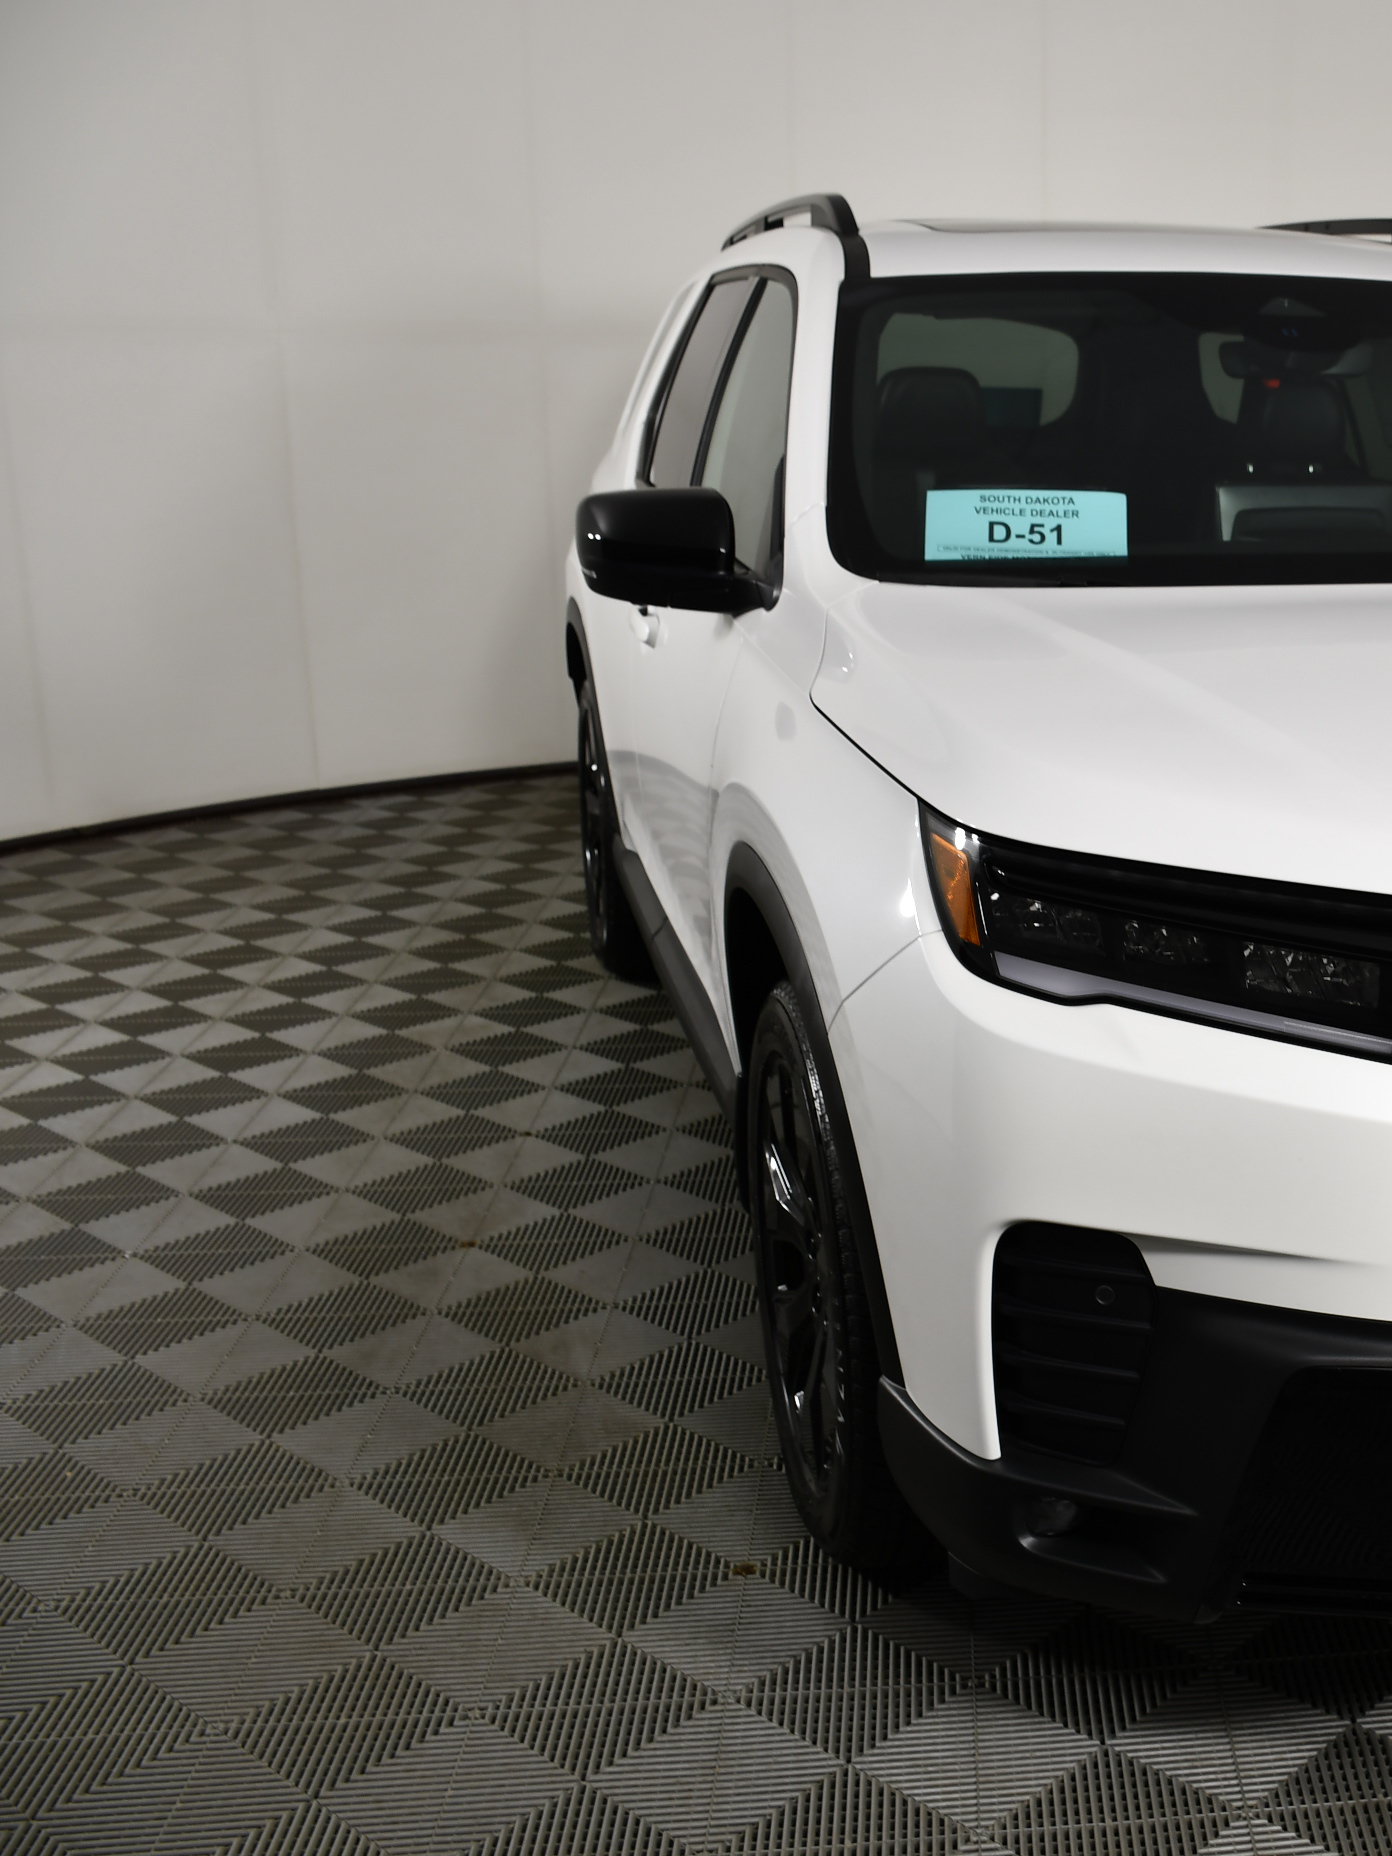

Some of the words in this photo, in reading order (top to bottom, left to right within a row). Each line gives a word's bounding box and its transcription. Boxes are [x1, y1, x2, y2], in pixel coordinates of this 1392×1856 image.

[979, 494, 1021, 505] SOUTH
[1025, 495, 1075, 506] DAKOTA
[974, 506, 1026, 518] VEHICLE
[1030, 508, 1079, 519] DEALER
[988, 521, 1063, 546] D-51
